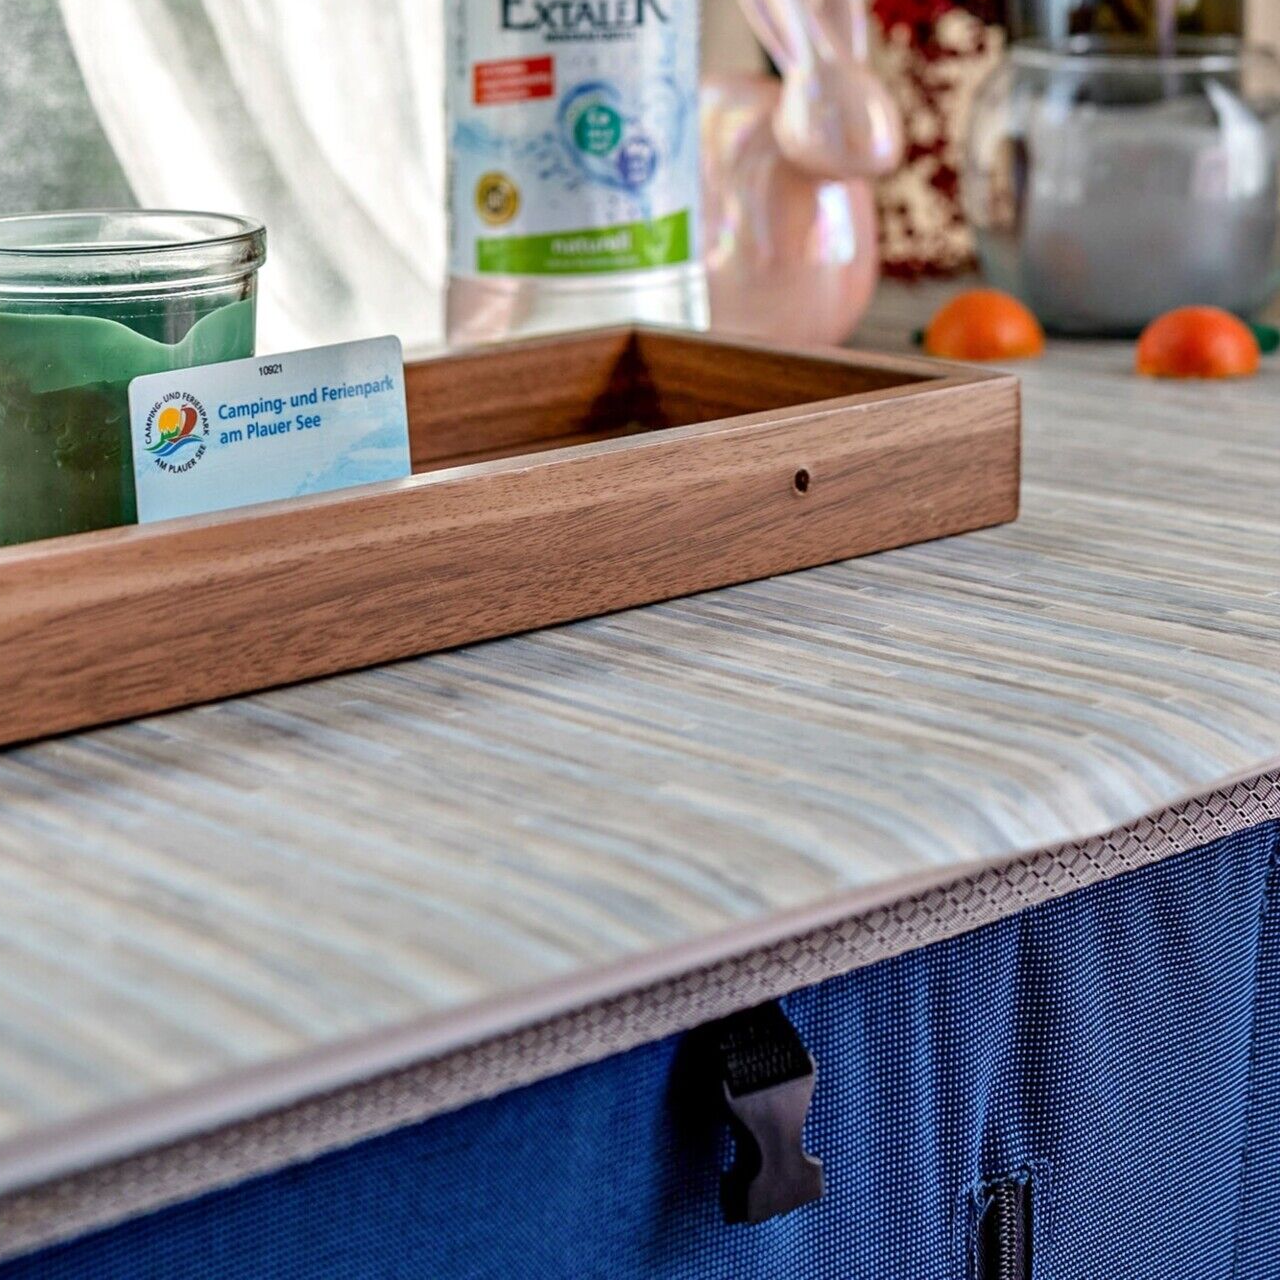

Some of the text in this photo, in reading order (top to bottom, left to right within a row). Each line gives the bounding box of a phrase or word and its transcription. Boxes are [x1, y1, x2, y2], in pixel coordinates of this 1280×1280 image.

[258, 363, 283, 376] 10921
[218, 374, 395, 420] Camping- und Ferienpark
[144, 391, 210, 445] CAMPING- UND FERIENPARK
[219, 414, 322, 444] am Plauer See
[154, 443, 207, 474] AM PLAUER SEE
